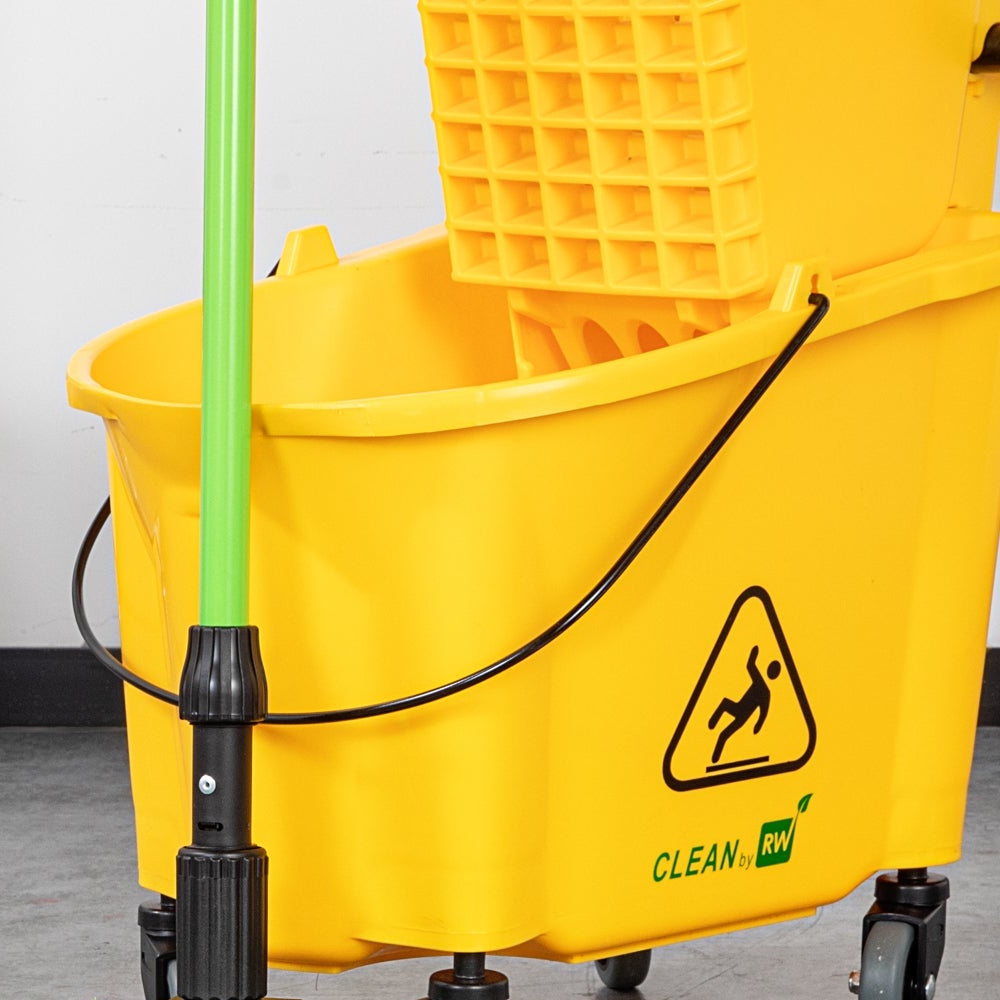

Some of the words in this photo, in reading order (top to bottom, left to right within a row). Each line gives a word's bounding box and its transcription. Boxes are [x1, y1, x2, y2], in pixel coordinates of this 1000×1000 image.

[653, 839, 739, 882] CLEAN
[738, 853, 754, 870] by
[761, 828, 795, 856] RW
